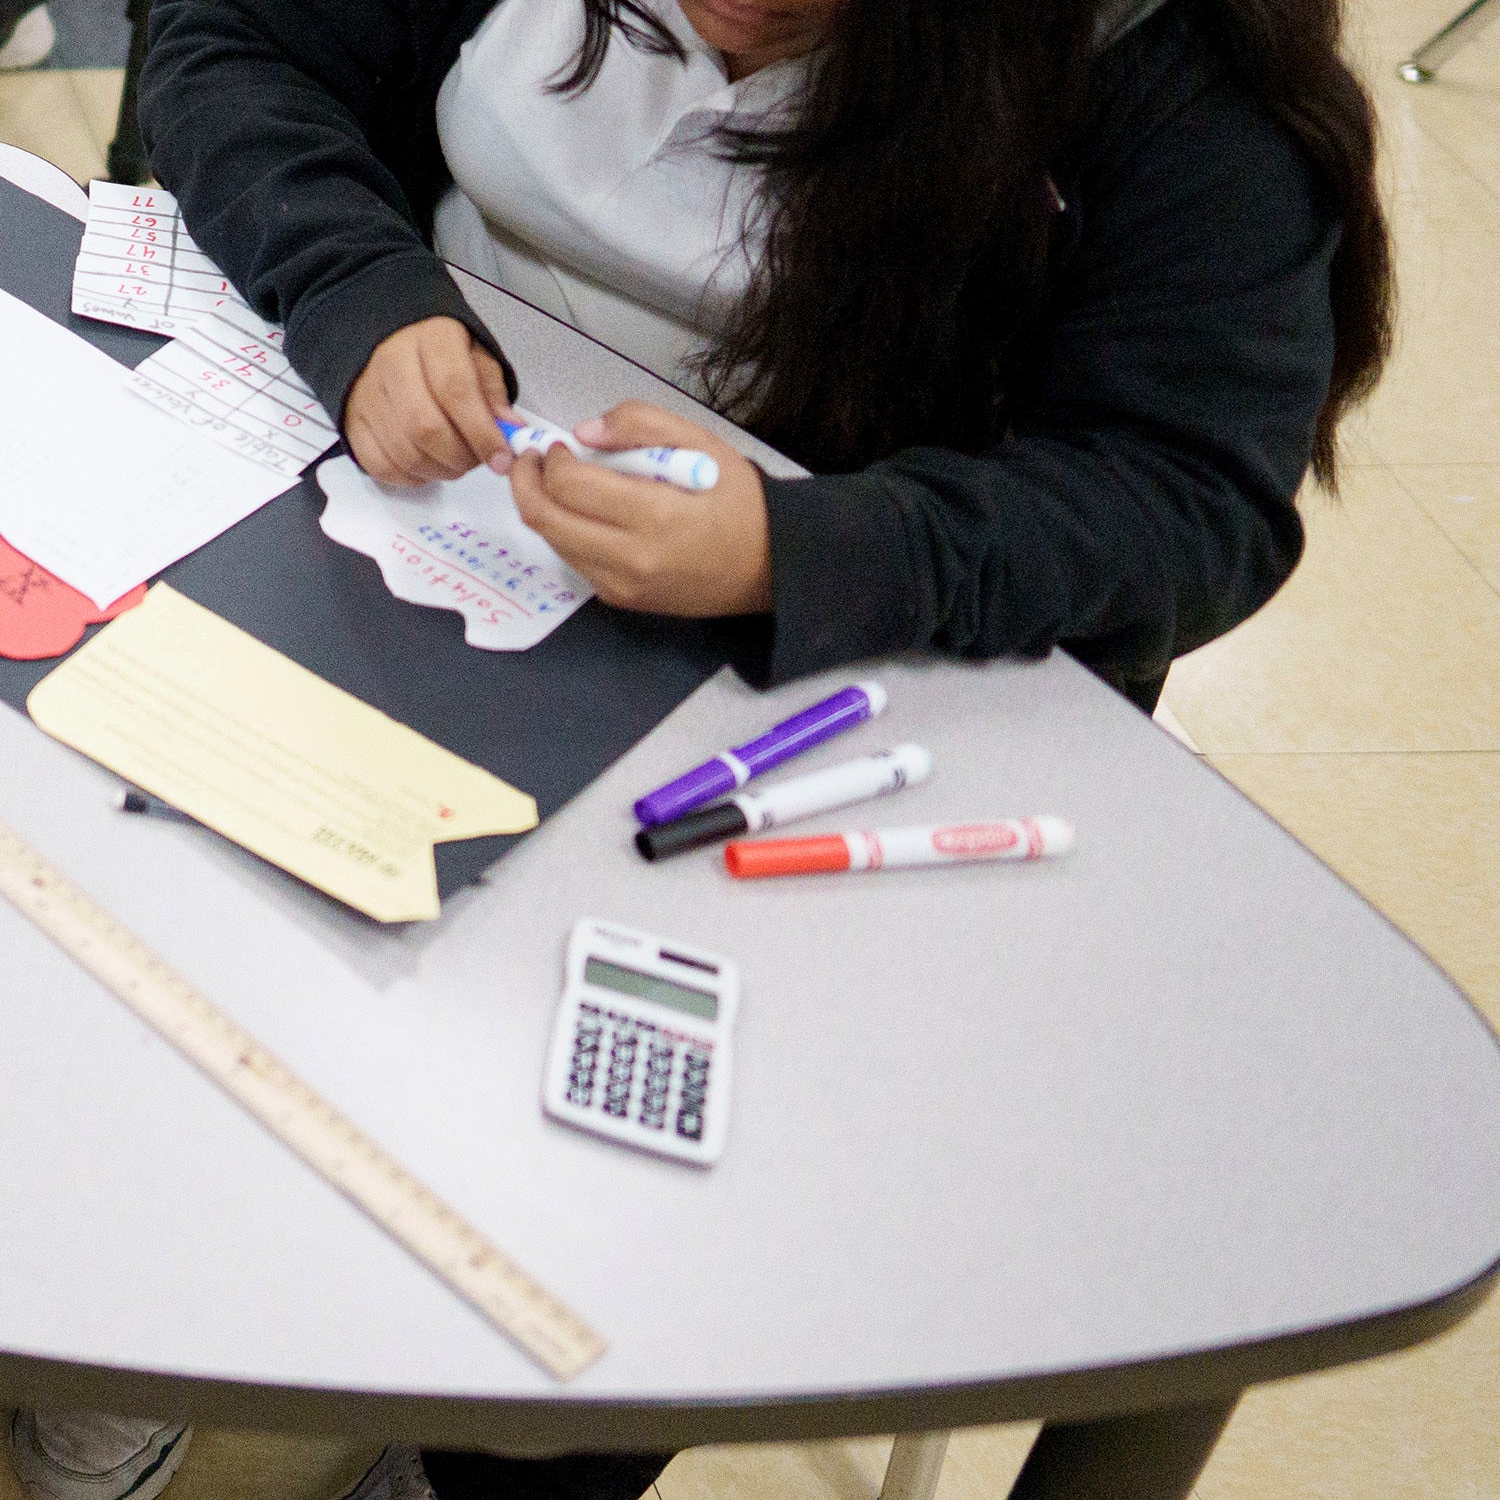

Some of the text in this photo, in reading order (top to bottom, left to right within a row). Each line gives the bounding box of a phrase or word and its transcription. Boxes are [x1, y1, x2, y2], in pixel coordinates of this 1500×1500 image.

[131, 195, 156, 209] 77
[131, 215, 158, 228] 67
[131, 228, 158, 243] 57
[126, 243, 157, 260] 47
[125, 262, 151, 277] 37
[118, 284, 148, 296] 27
[239, 344, 268, 365] 47
[223, 357, 253, 378] 41
[201, 370, 232, 391] 35
[233, 432, 288, 472] Table
[391, 540, 514, 625] Solution
